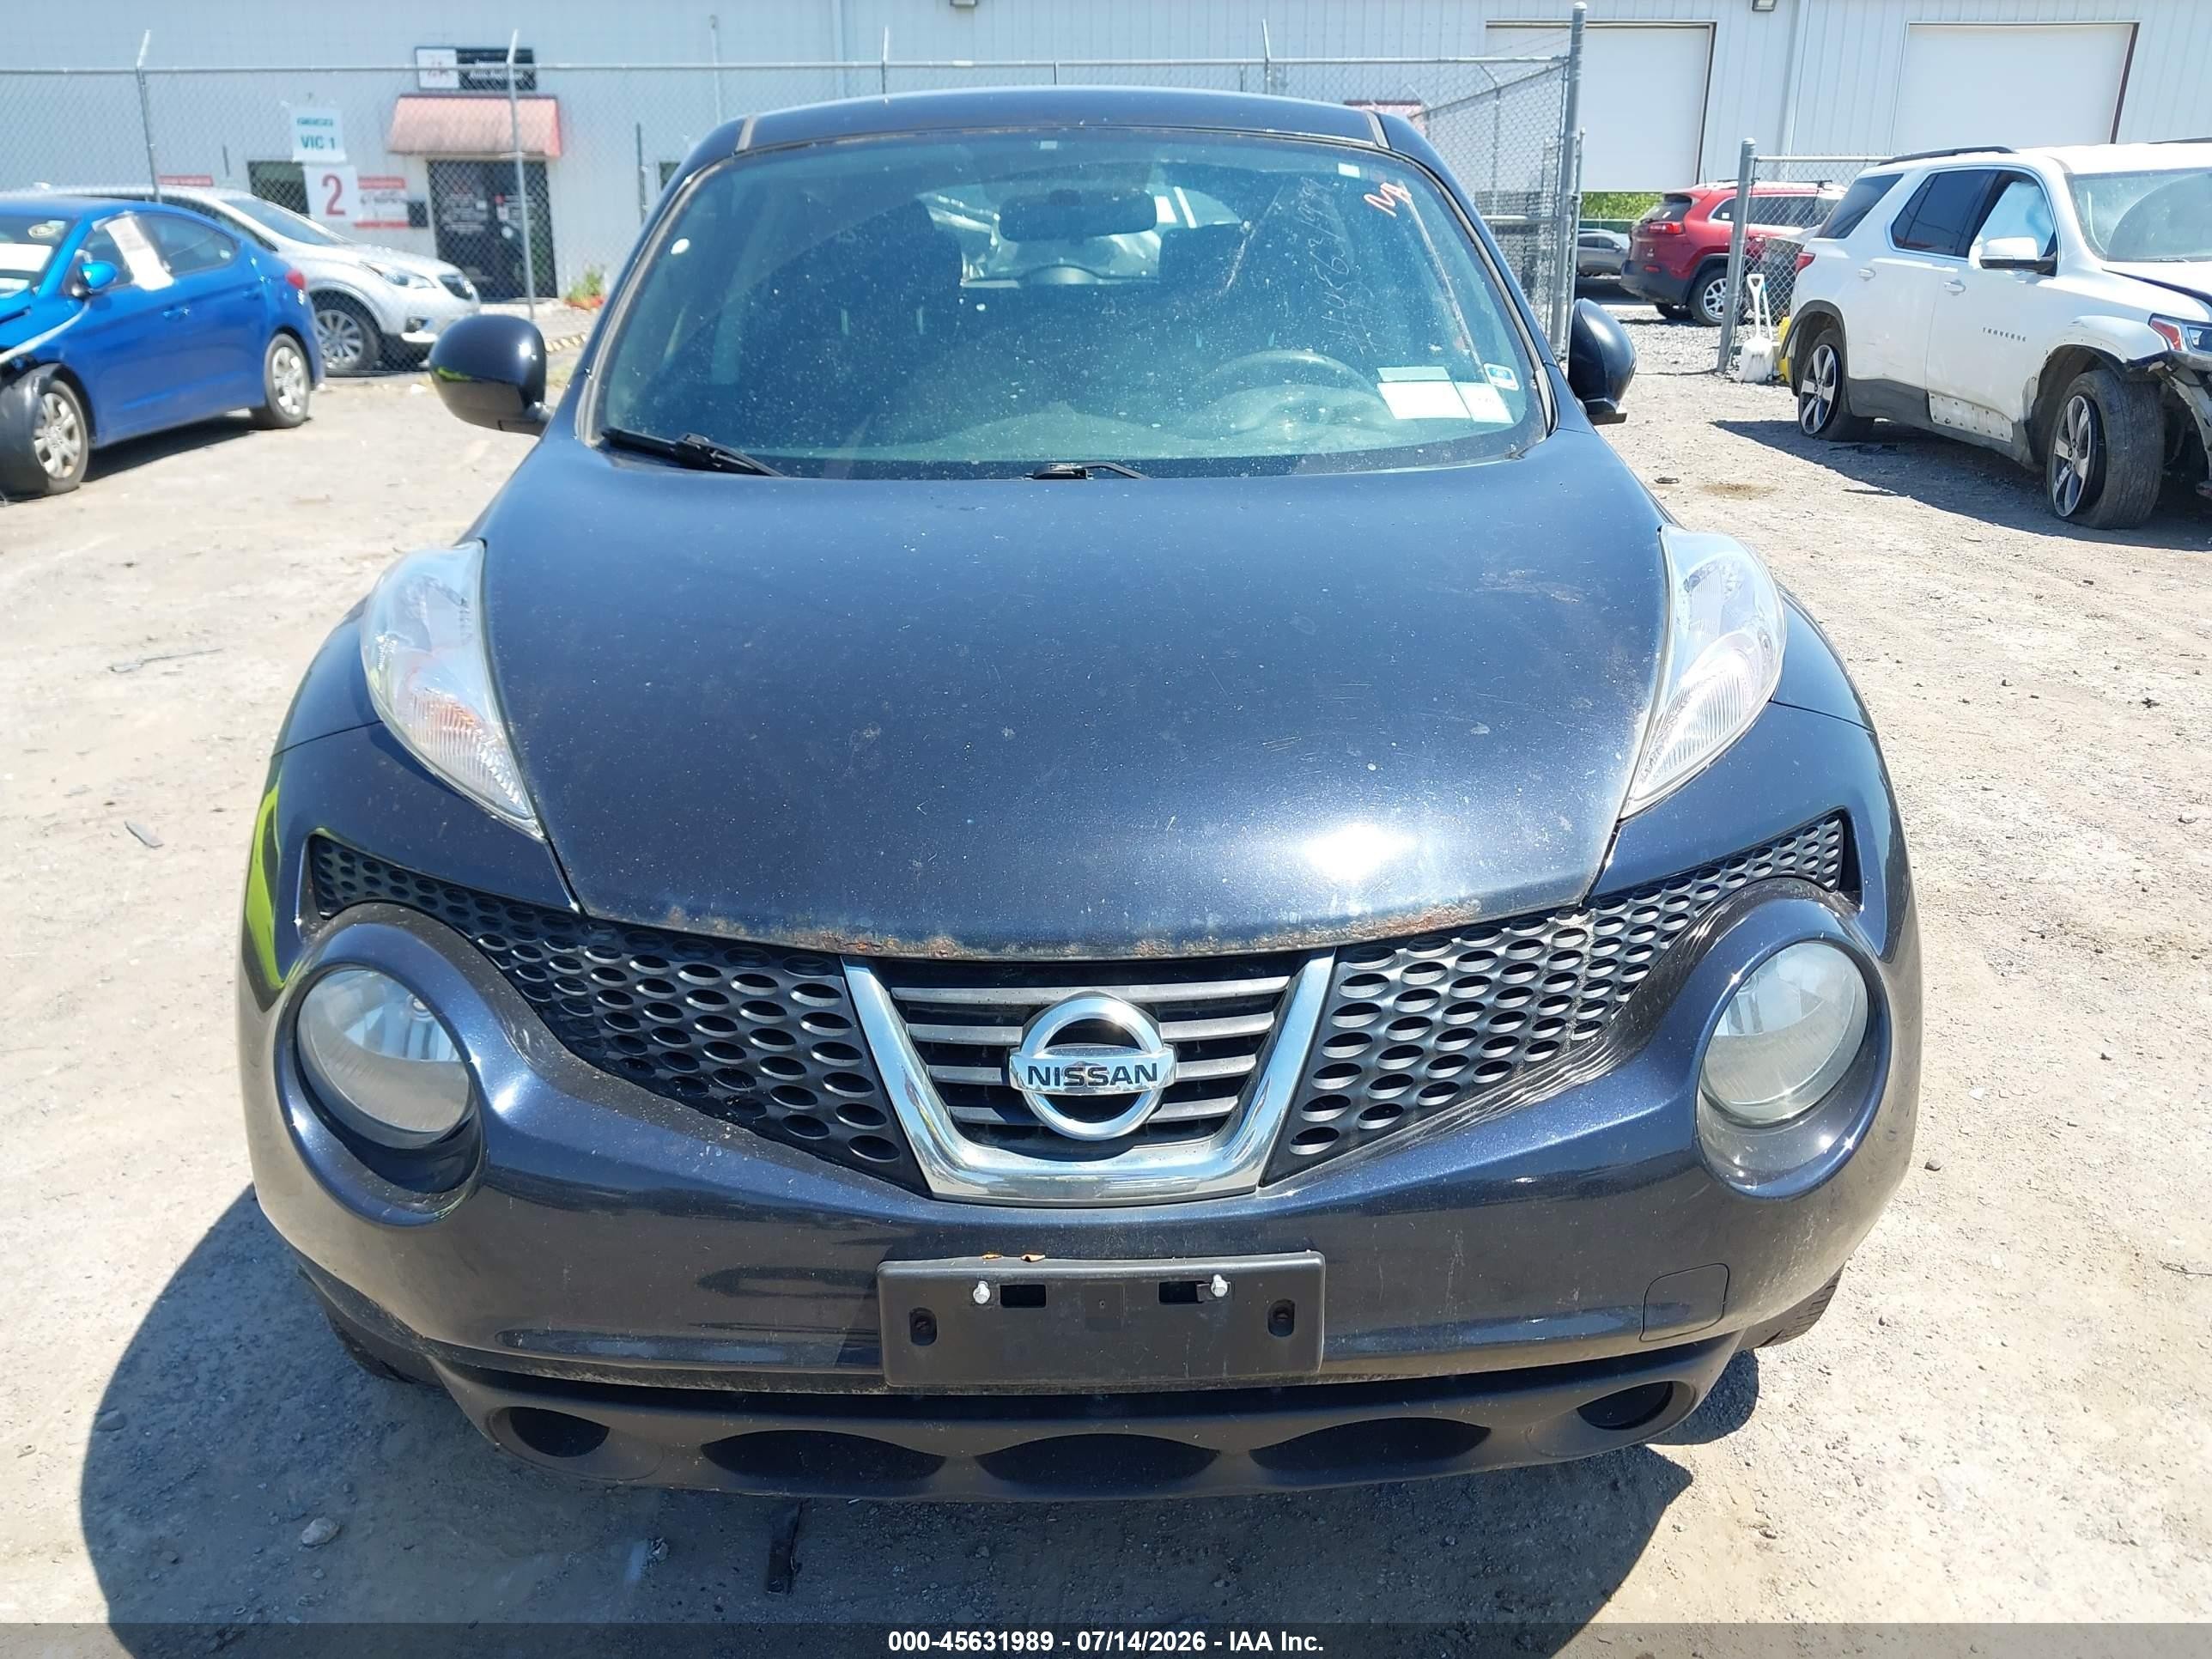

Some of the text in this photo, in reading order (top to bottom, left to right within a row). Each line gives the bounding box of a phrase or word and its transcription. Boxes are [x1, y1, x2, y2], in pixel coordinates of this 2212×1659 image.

[300, 135, 336, 149] VIC 1
[322, 174, 346, 216] 2
[1983, 327, 2027, 342] TRAVERSE
[1027, 1062, 1158, 1087] NISSAN
